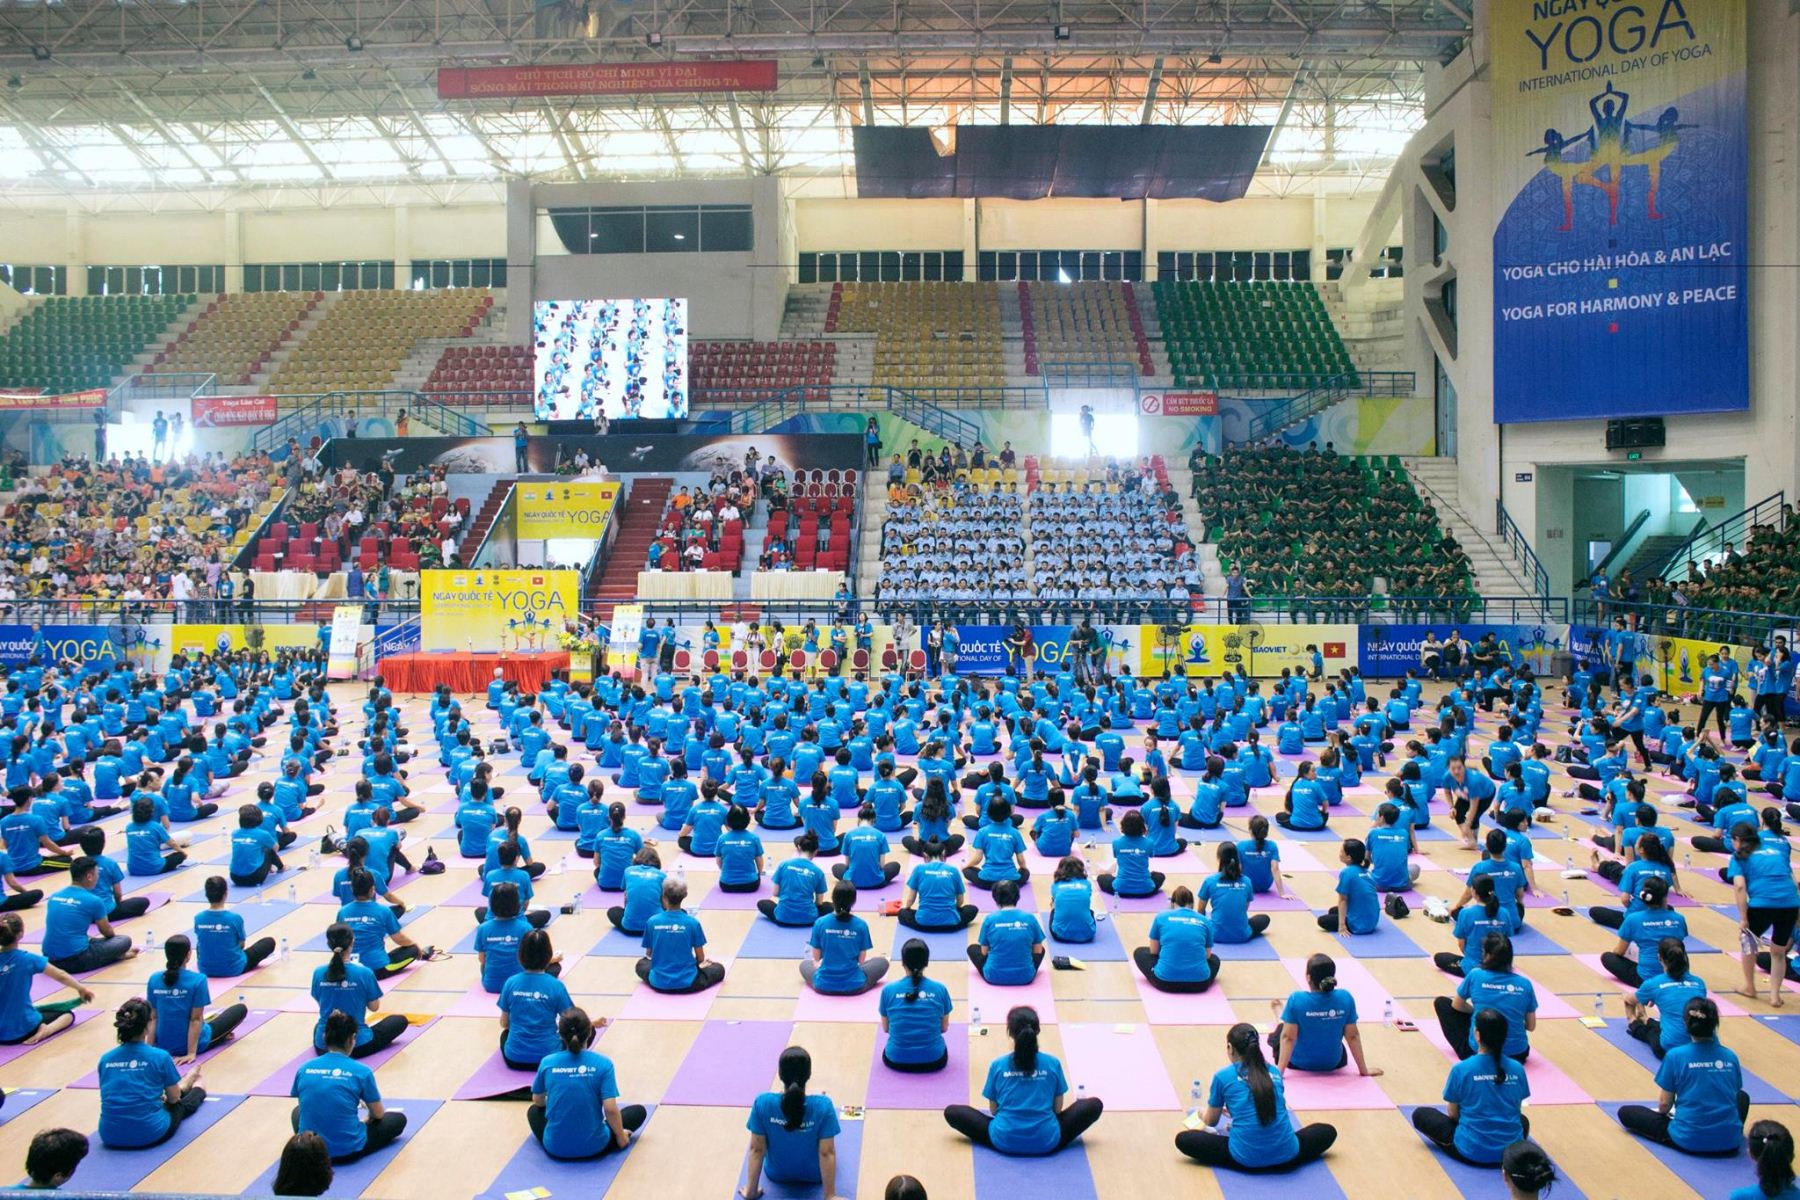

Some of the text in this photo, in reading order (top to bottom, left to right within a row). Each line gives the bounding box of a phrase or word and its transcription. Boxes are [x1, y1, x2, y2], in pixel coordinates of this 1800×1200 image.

[1525, 0, 1696, 70] YOGA
[620, 69, 655, 78] MINH
[1519, 43, 1713, 93] INTERNATIONAL DAY OF YOGA
[725, 78, 741, 88] TA
[1503, 265, 1544, 281] YOGA
[1547, 260, 1580, 276] CHO
[1583, 255, 1611, 272] HÀI
[1655, 250, 1667, 264] &
[1670, 246, 1695, 261] AN
[1698, 242, 1732, 262] LẠC
[1502, 285, 1737, 321] YOGA FOR HARMONY & PEACE
[496, 591, 565, 610] YOGA
[46, 640, 117, 661] YOGA
[1253, 646, 1287, 654] BAOVIET
